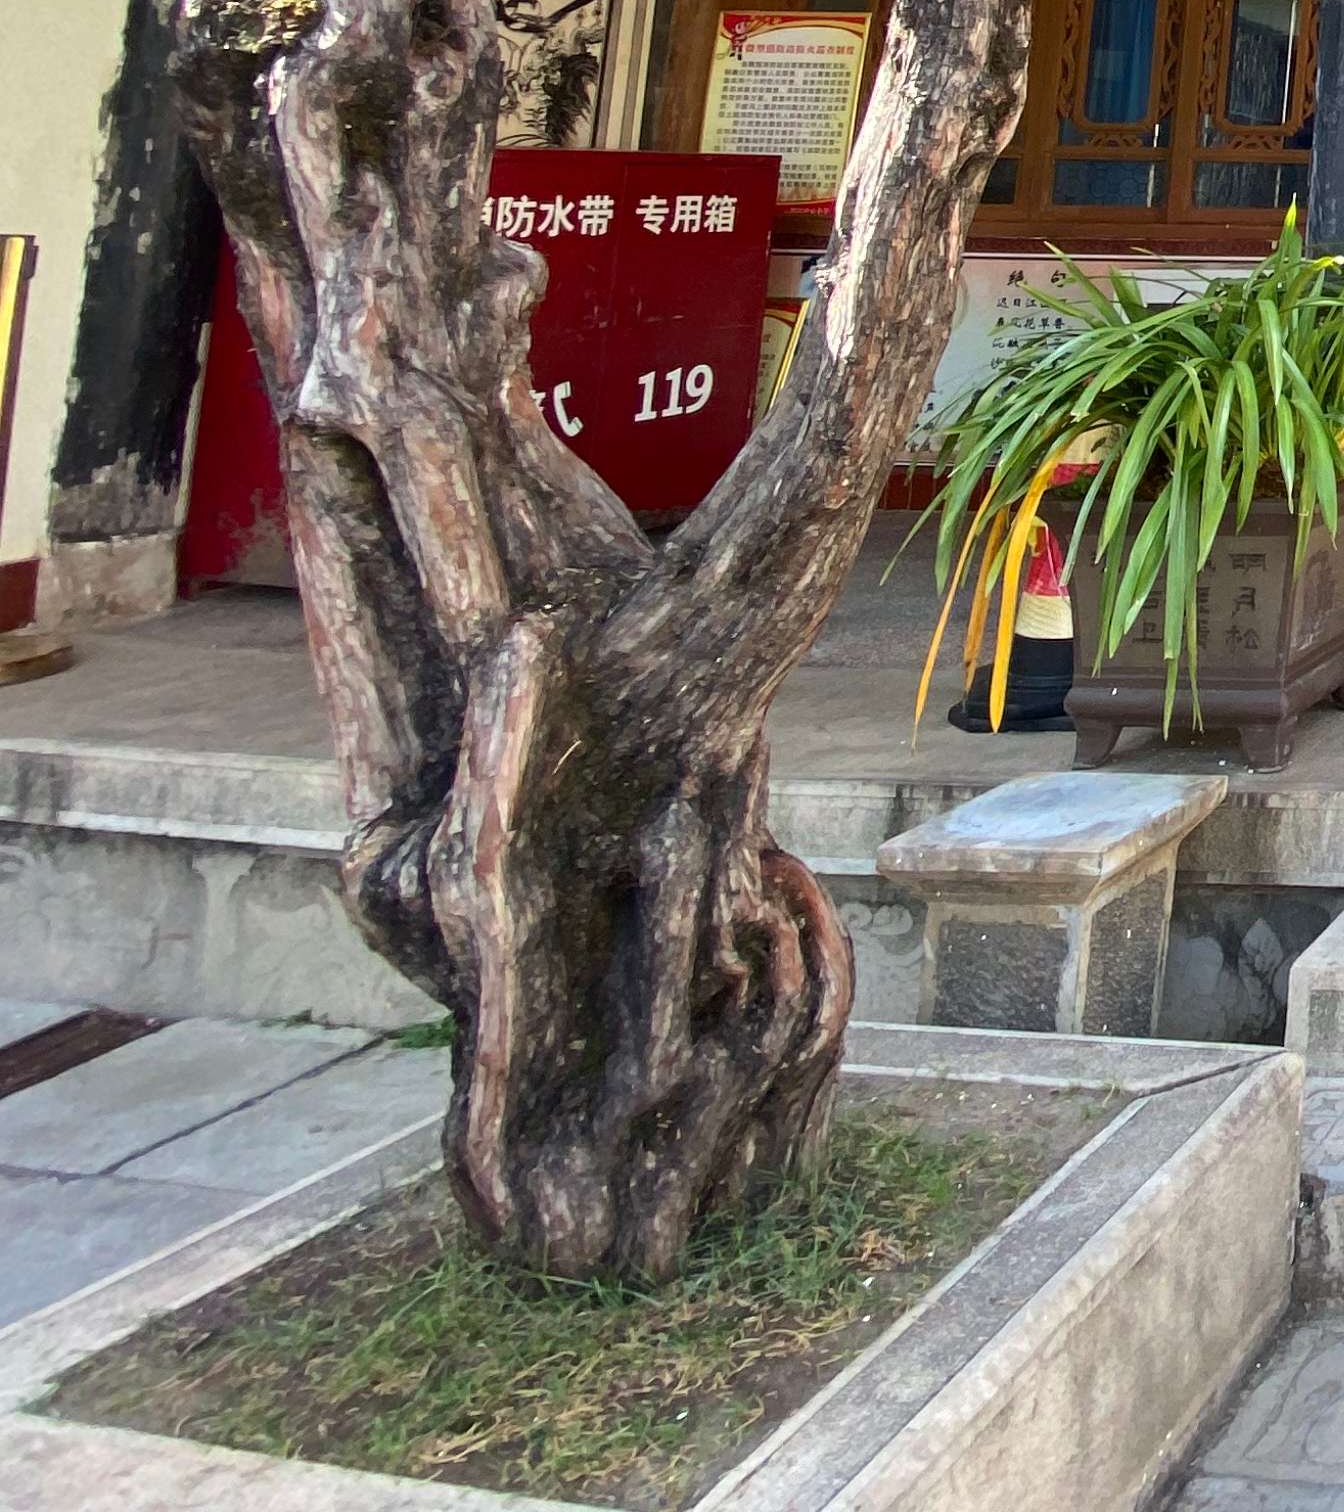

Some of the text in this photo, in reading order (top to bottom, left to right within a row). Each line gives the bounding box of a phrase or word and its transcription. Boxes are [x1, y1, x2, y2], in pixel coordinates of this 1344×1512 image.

[635, 194, 738, 235] 专用箱
[634, 364, 714, 422] 119
